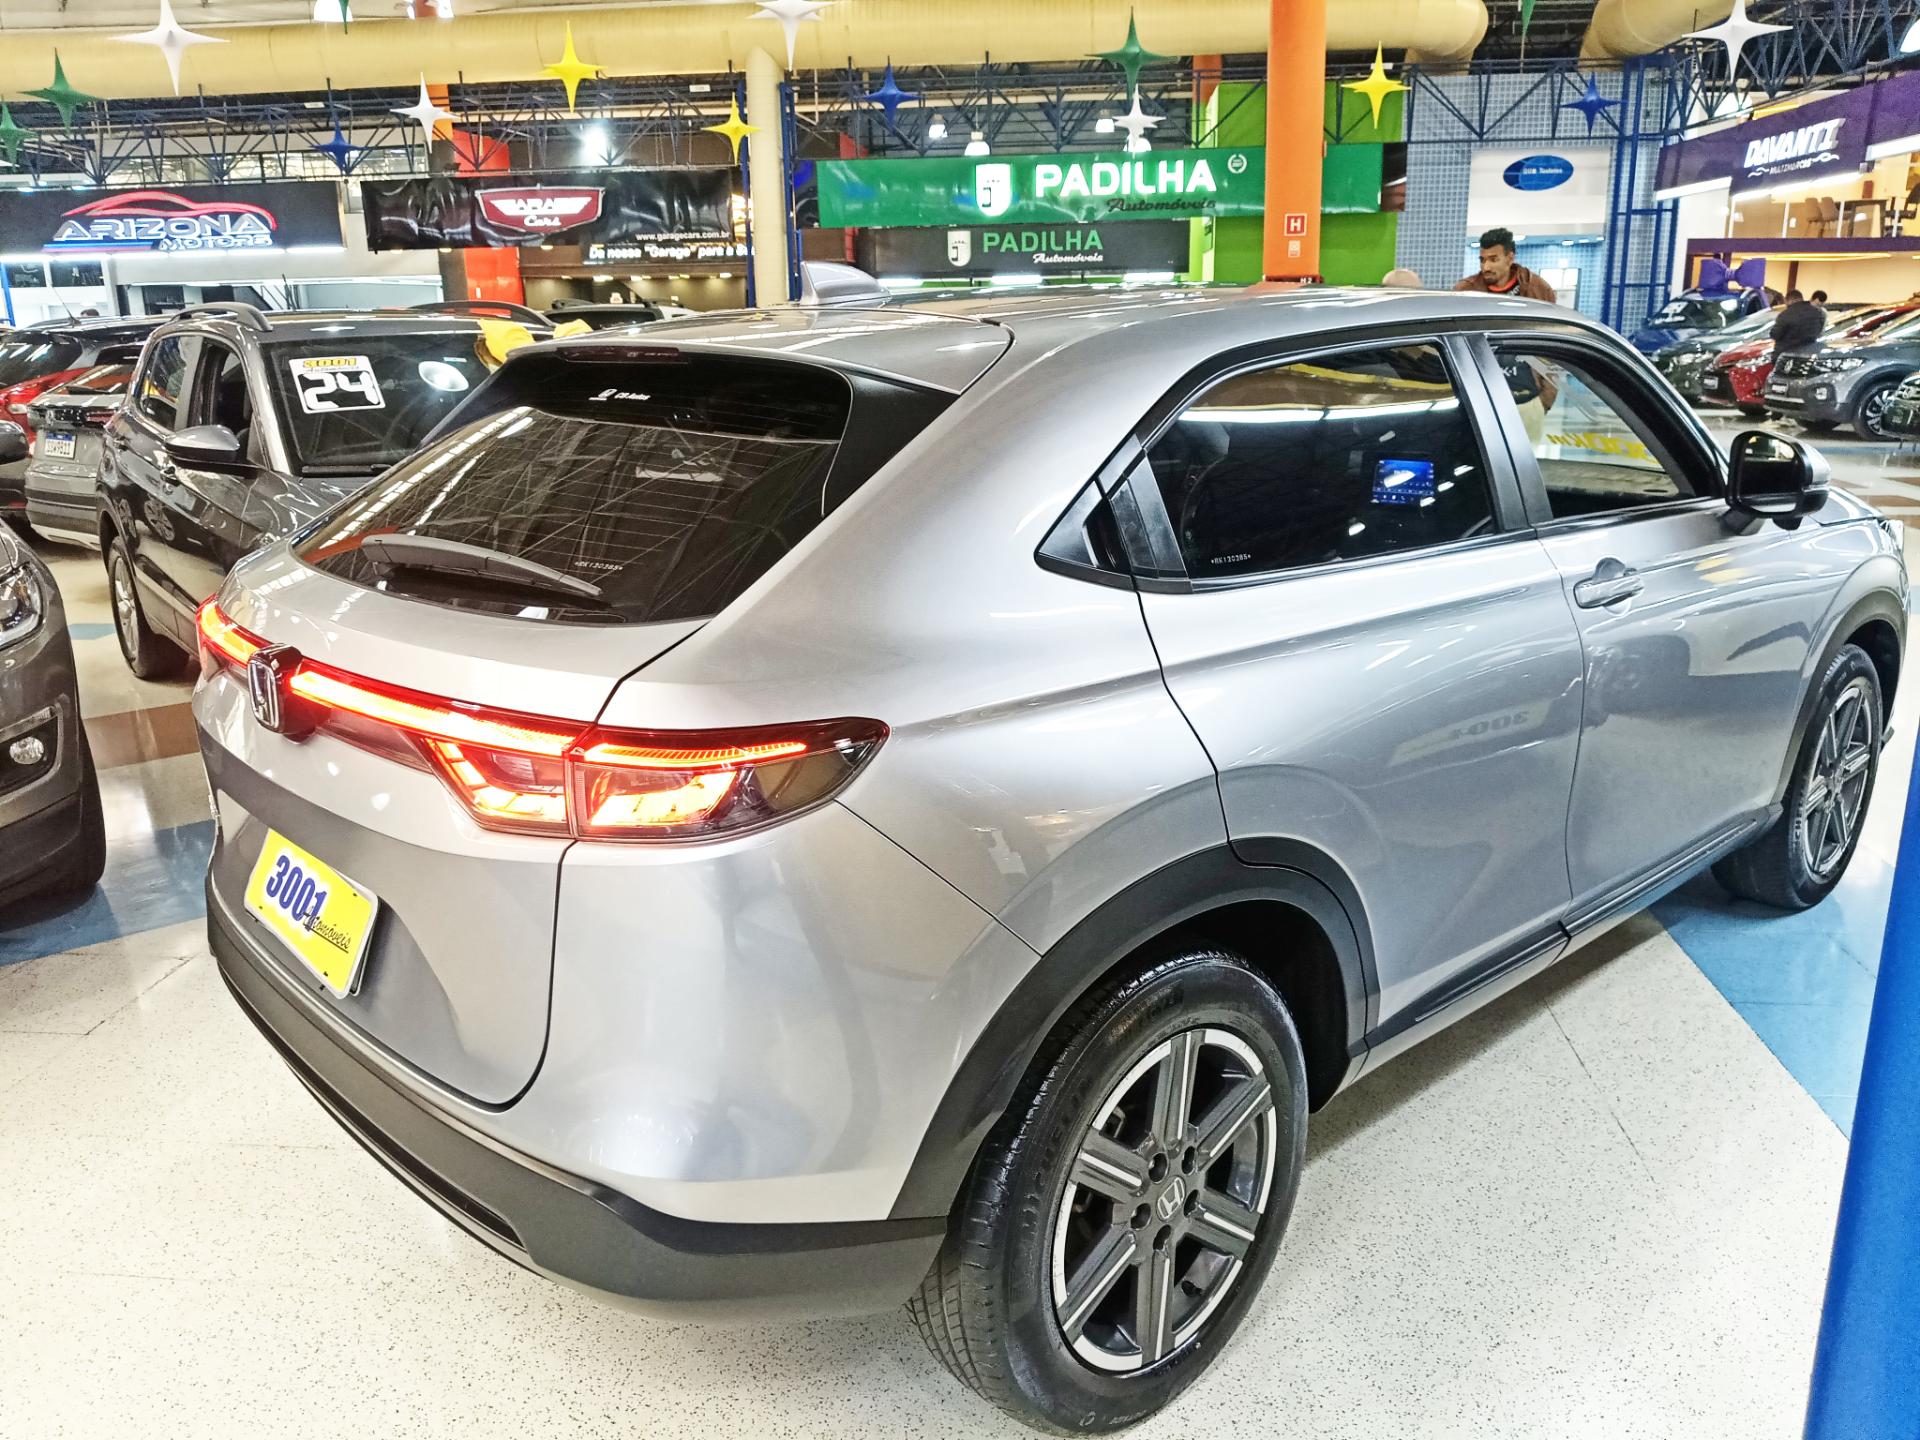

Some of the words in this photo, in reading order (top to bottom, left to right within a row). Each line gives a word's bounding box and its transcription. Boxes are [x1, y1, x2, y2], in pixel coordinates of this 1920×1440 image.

[1744, 118, 1846, 168] DAVANTI
[1035, 159, 1217, 198] PADILHA
[53, 213, 272, 242] ARIZONA
[523, 214, 562, 226] Cars
[1290, 218, 1301, 232] H
[158, 233, 273, 251] MOTORS
[636, 231, 730, 242] www.garagecars.com.br
[983, 229, 1104, 253] PADILHA
[1032, 252, 1104, 264] Automóveis
[302, 371, 380, 410] 24
[266, 855, 327, 931] 3001
